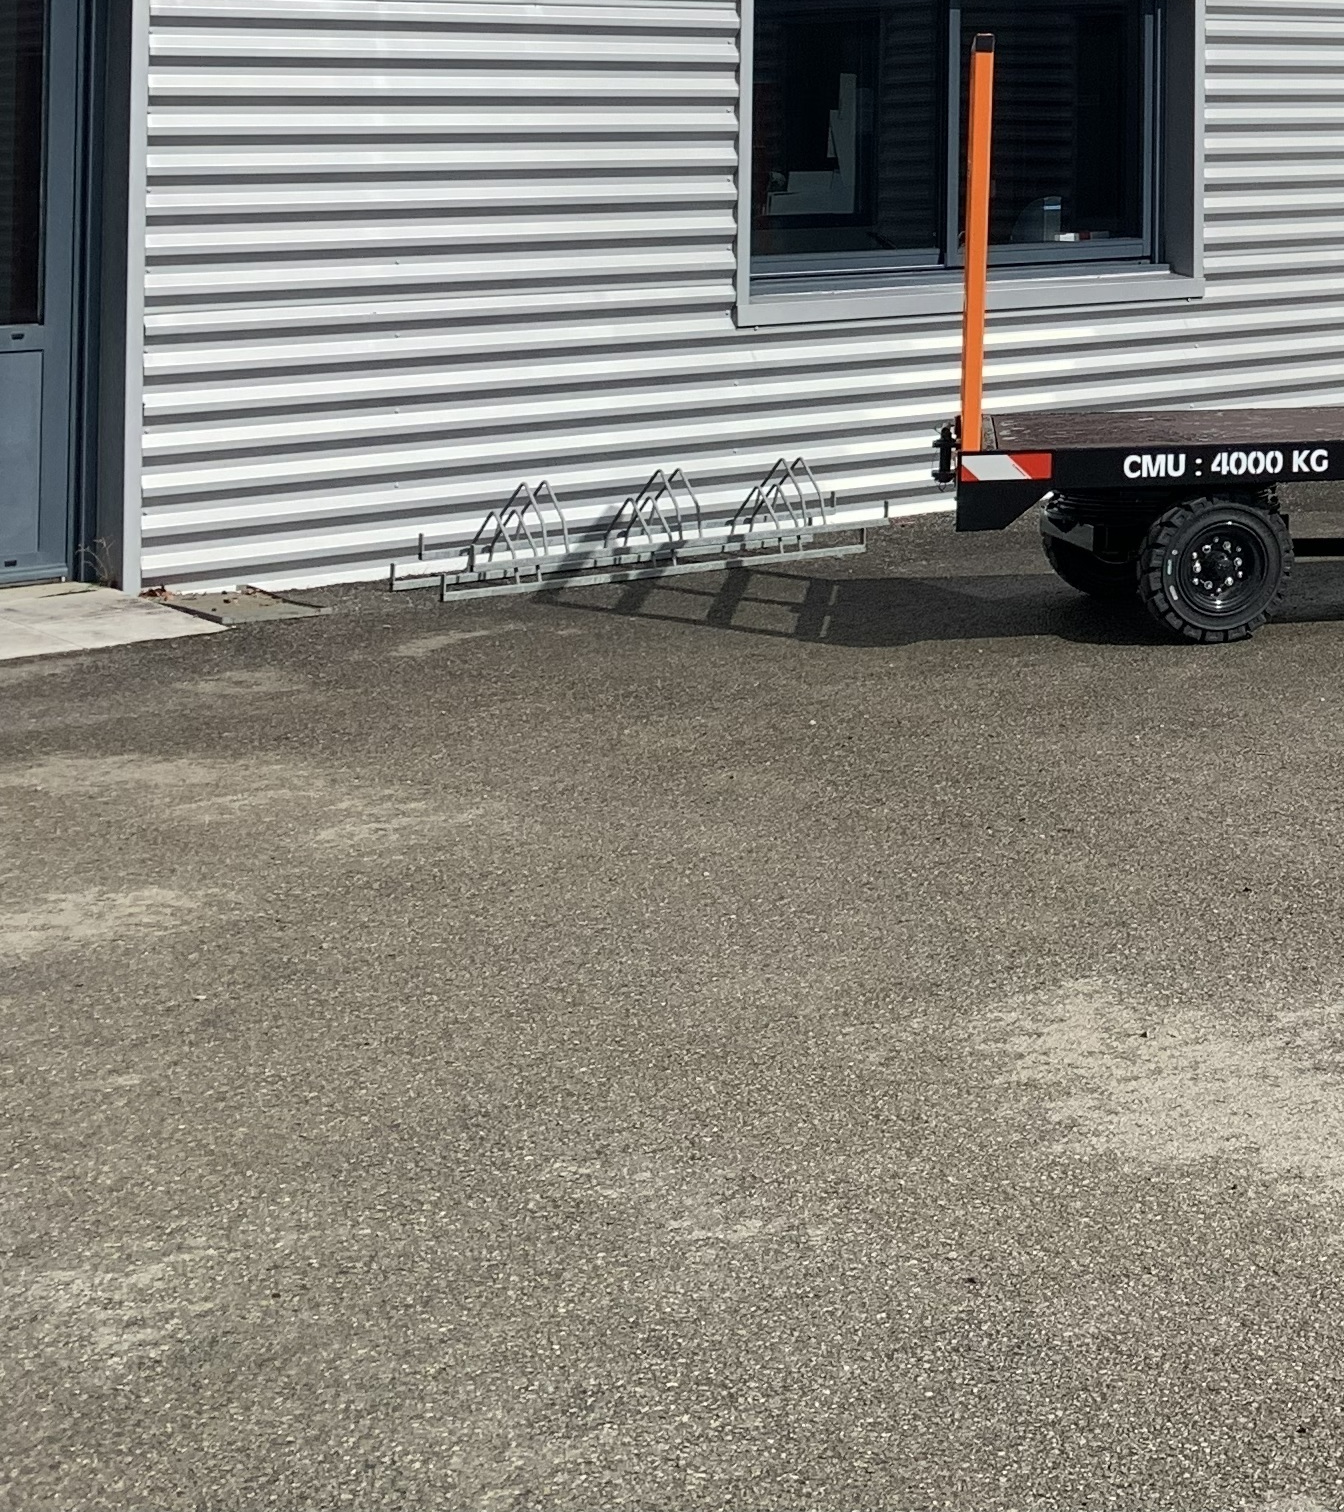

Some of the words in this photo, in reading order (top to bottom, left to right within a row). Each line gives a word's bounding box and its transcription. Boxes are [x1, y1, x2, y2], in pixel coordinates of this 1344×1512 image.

[1123, 452, 1186, 479] CMU
[1210, 450, 1284, 476] 4000
[1292, 448, 1329, 473] KG
